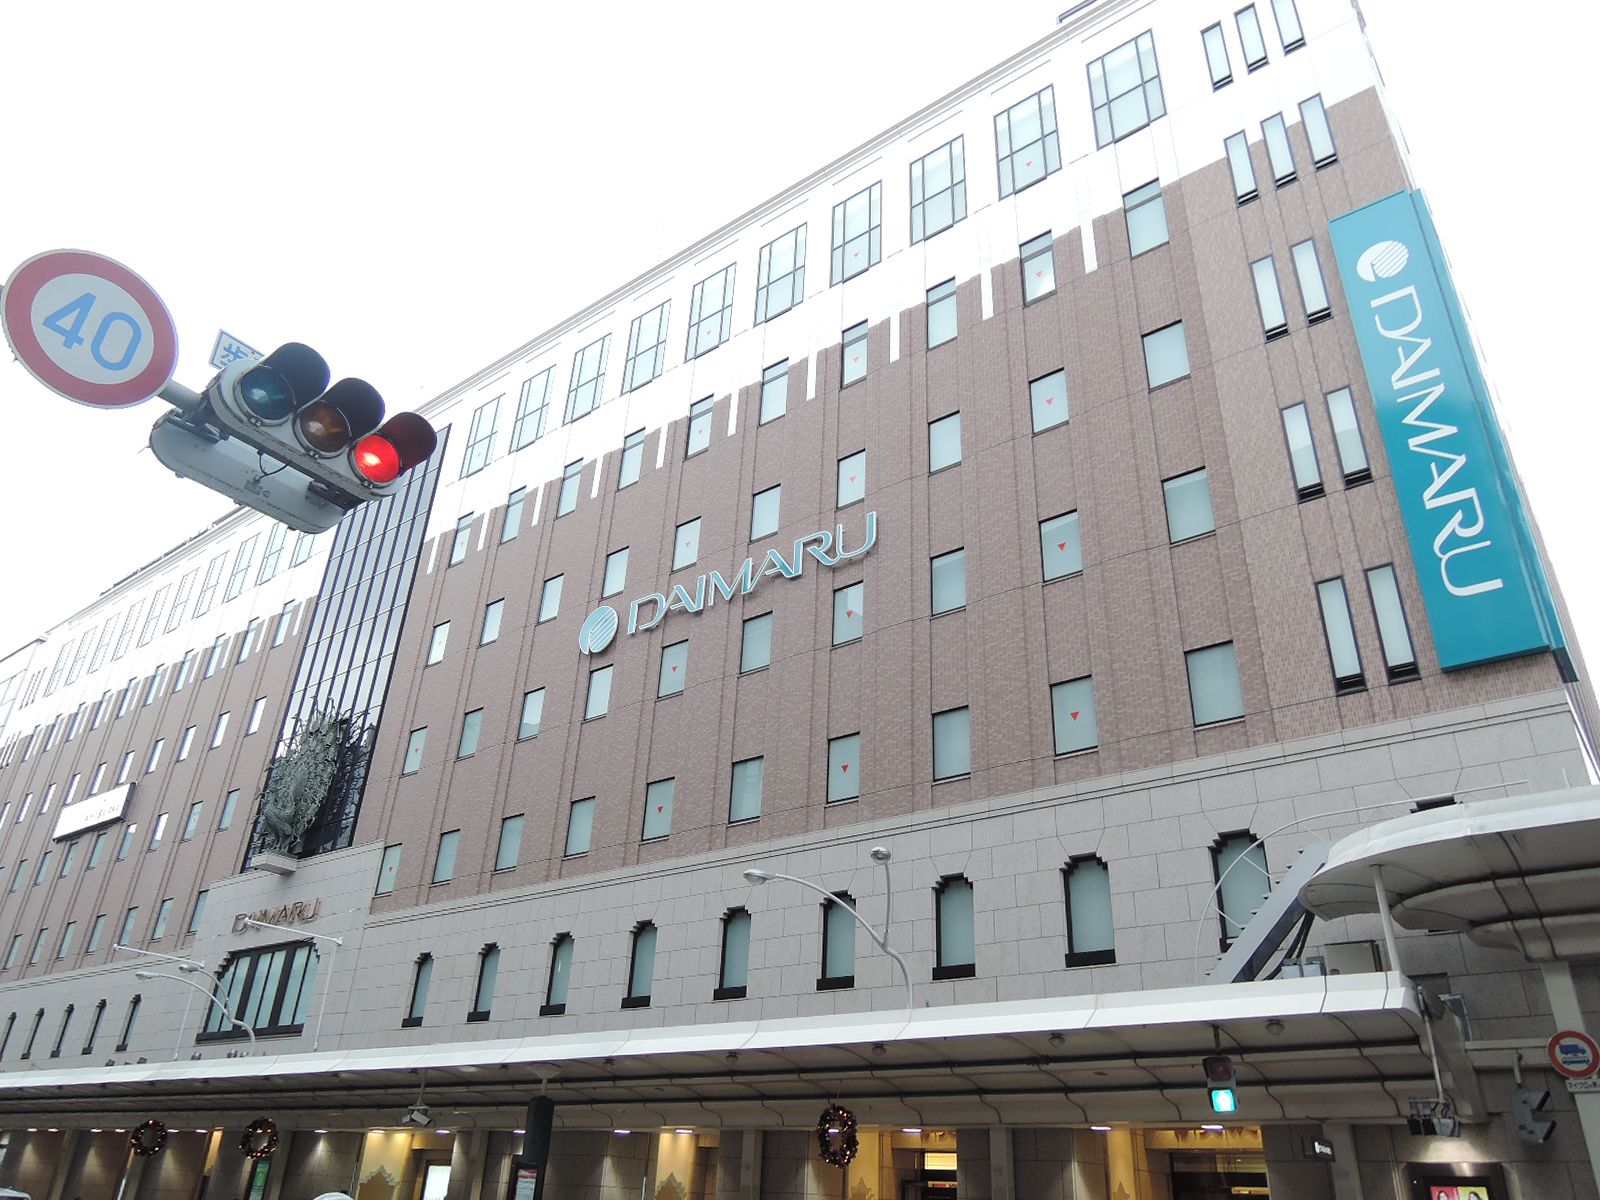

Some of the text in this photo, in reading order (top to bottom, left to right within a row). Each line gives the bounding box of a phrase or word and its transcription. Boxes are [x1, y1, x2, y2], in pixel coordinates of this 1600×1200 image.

[42, 292, 142, 371] 40
[1370, 285, 1503, 597] DAIMARU
[627, 511, 877, 634] DAIMARU
